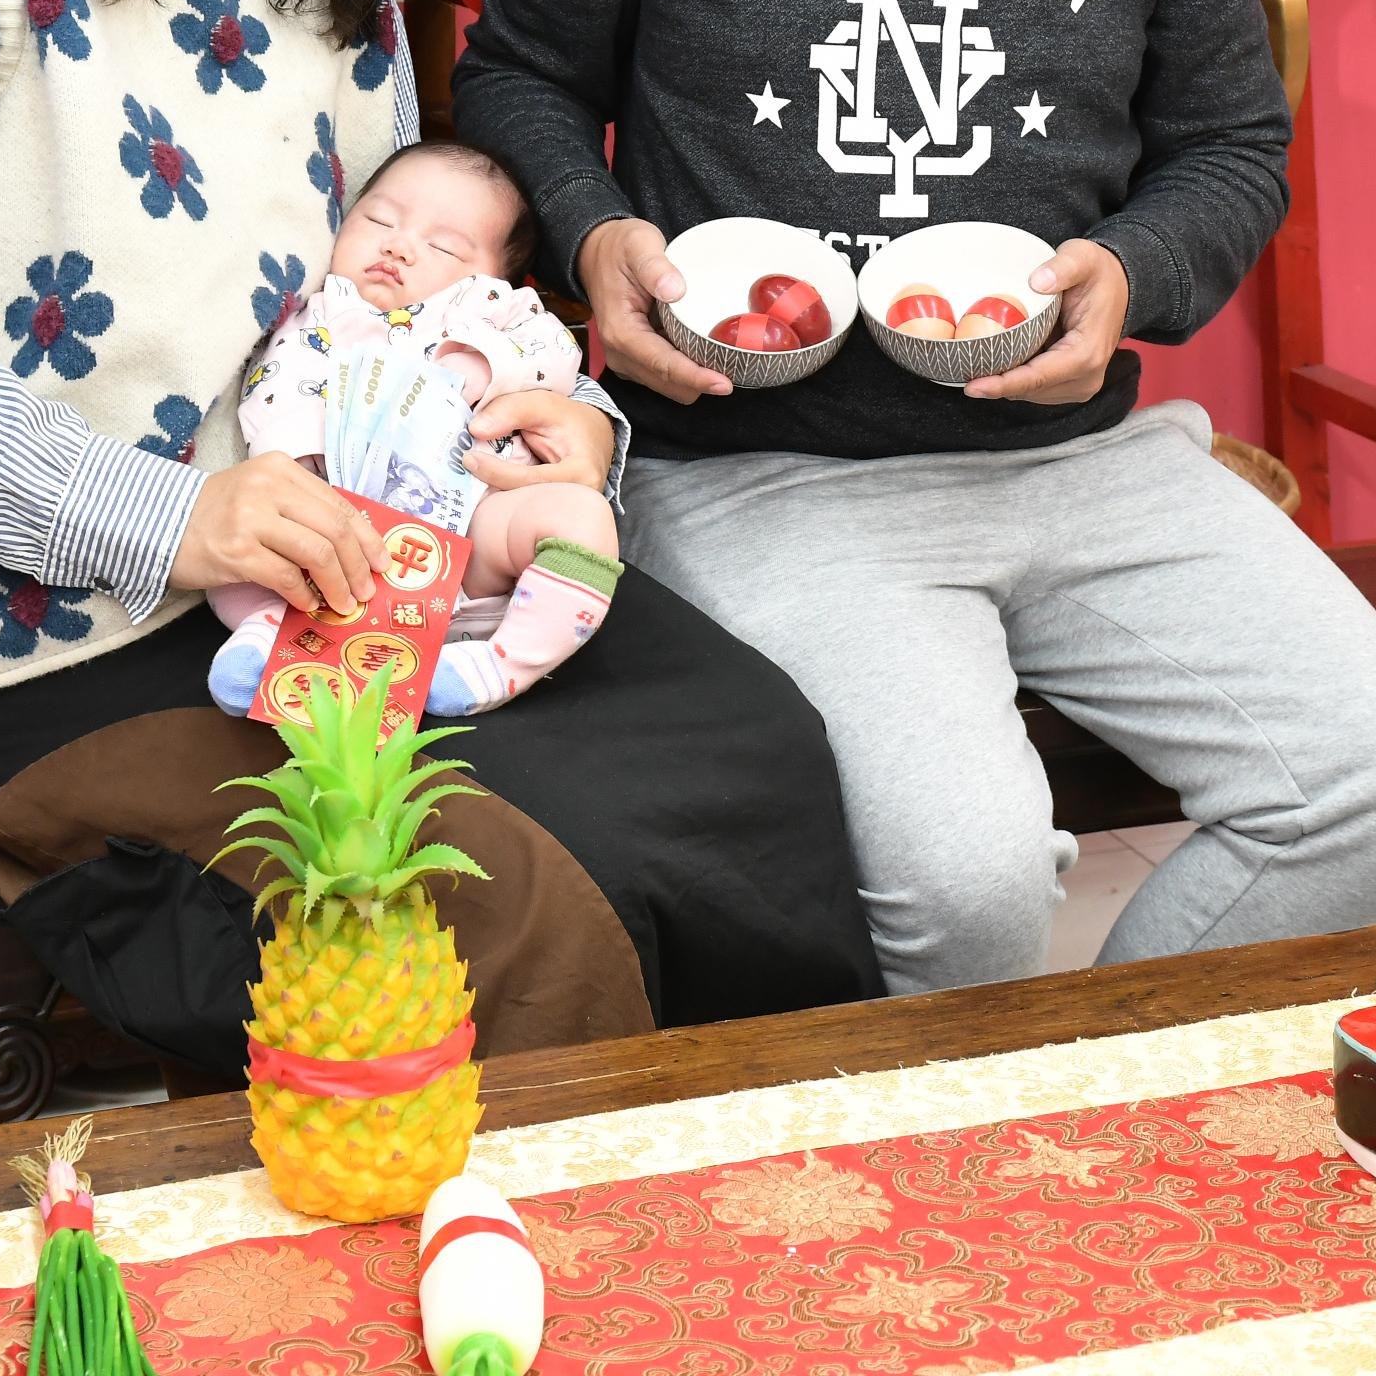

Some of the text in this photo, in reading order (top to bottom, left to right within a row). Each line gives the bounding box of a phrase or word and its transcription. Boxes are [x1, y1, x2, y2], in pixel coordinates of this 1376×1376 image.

[364, 356, 385, 405] 1000
[399, 374, 427, 417] 1000
[391, 535, 433, 578] 平
[393, 604, 423, 625] 福
